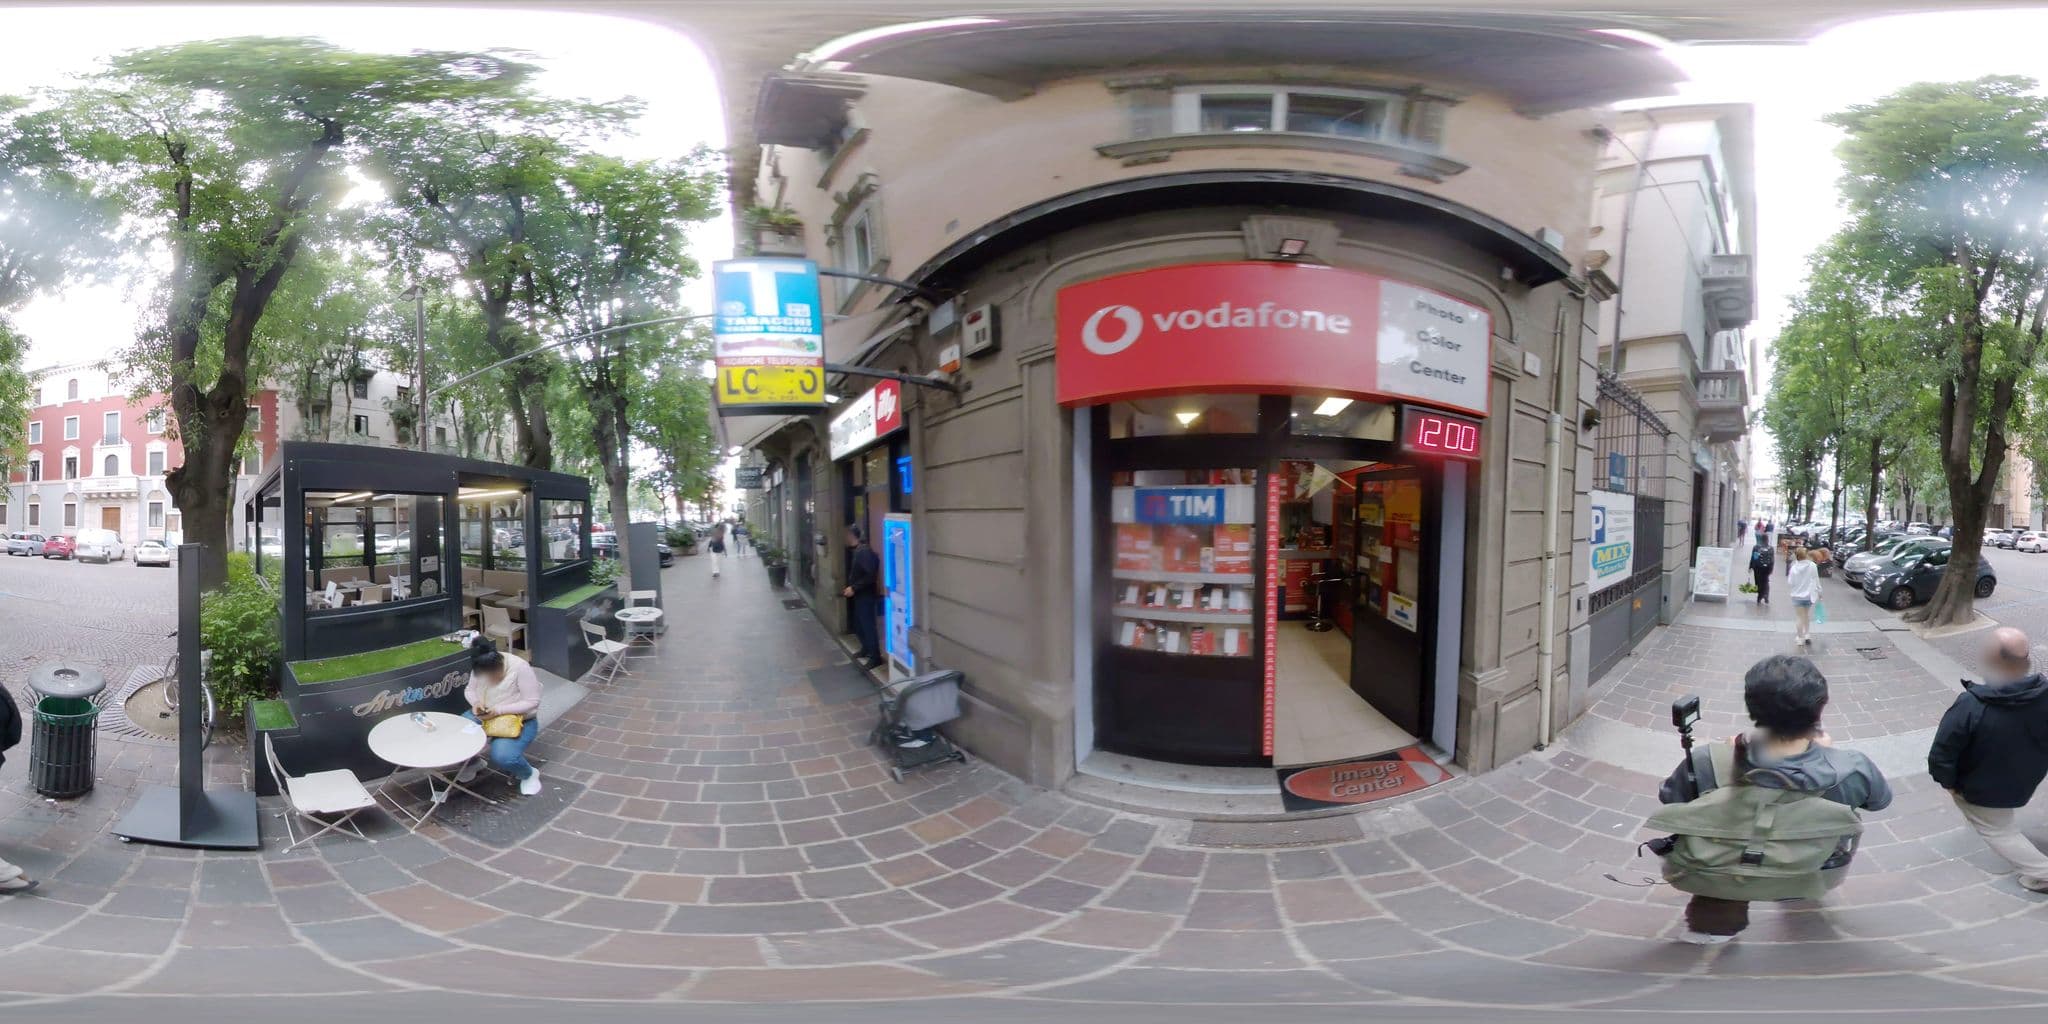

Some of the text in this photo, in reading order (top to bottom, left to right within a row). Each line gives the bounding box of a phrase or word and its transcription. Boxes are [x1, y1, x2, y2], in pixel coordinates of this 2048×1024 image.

[724, 316, 813, 327] TABACCHI
[1152, 301, 1353, 335] vodafone
[1415, 300, 1465, 325] Photo
[1416, 328, 1463, 354] Color
[1410, 360, 1467, 386] Center
[1168, 495, 1216, 518] TIM
[1591, 509, 1604, 542] P
[1598, 545, 1627, 563] MIX
[1331, 761, 1399, 783] Image
[1330, 774, 1406, 798] Center
